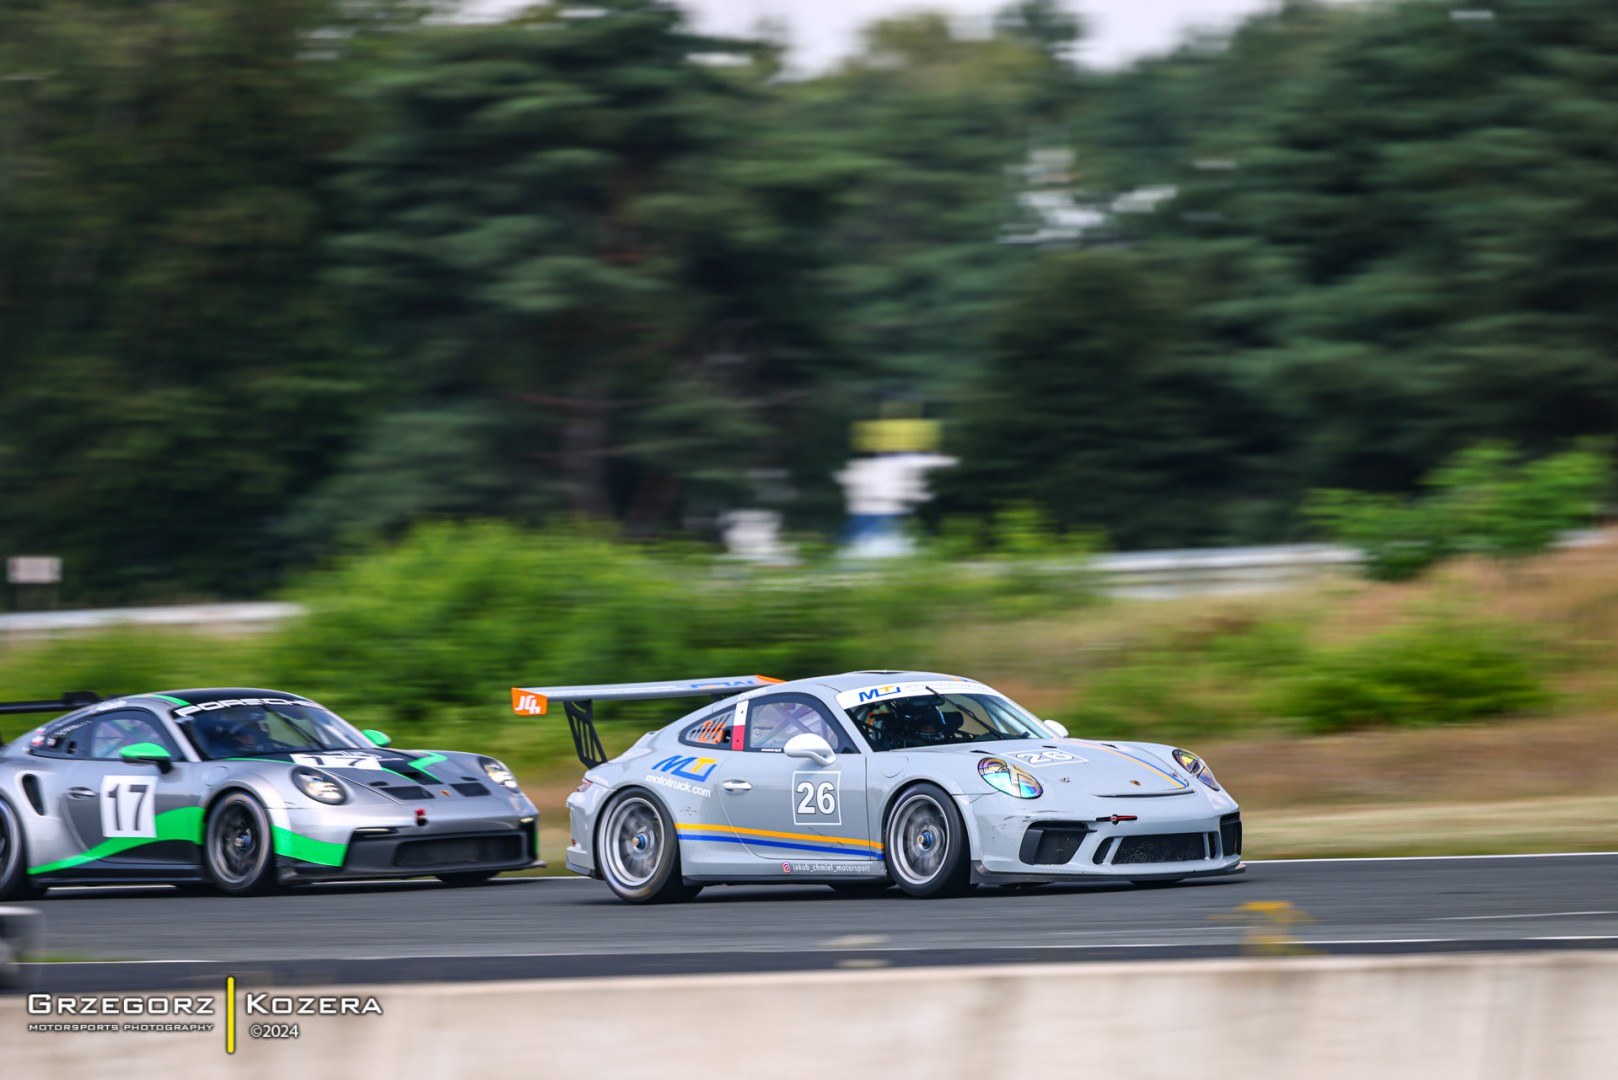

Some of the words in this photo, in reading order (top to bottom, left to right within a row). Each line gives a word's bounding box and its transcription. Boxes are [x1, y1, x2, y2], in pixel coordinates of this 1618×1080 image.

[1016, 751, 1075, 763] 26
[645, 774, 711, 797] mototruck.com
[796, 781, 836, 815] 26
[108, 783, 149, 831] 17
